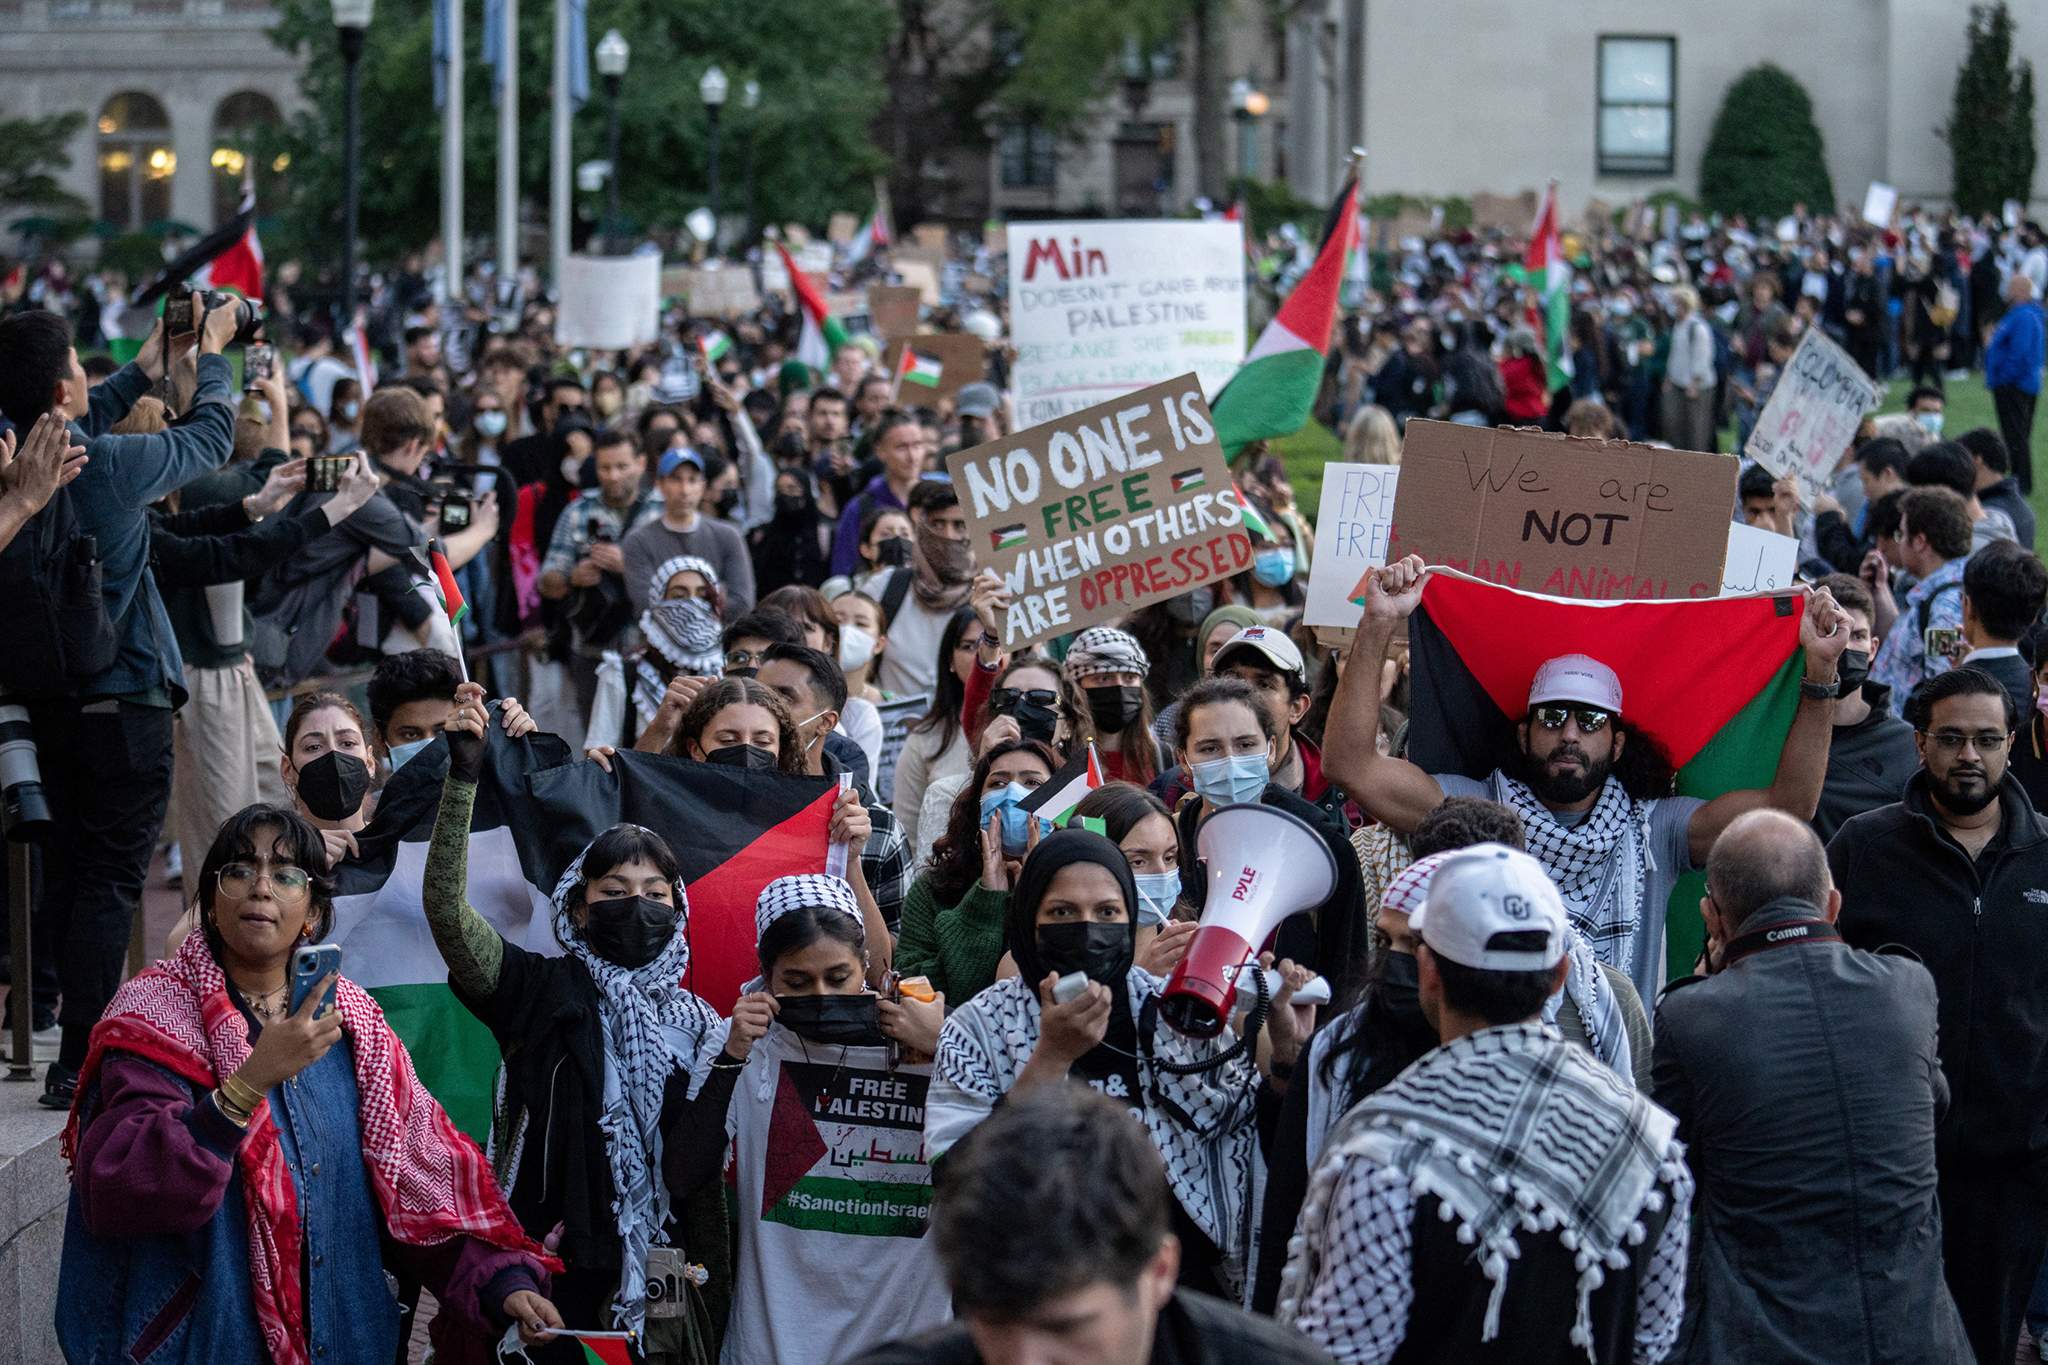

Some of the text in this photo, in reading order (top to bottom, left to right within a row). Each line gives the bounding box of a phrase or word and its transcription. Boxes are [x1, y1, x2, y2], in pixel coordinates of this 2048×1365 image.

[1023, 237, 1108, 281] Min
[1139, 277, 1199, 297] CARE
[1066, 302, 1208, 336] PALESTINE
[963, 391, 1214, 519] NO ONE IS
[1340, 472, 1397, 520] FRE
[1462, 450, 1673, 512] We are
[1042, 472, 1153, 539] FREE
[983, 489, 1243, 596] WHEN OTHERS
[1521, 509, 1629, 546] NOT
[1005, 533, 1251, 646] ARE OPPRESSED
[1231, 866, 1256, 901] PYLE
[1766, 926, 1808, 942] Canon
[849, 1077, 907, 1100] FREE
[815, 1095, 923, 1124] PALESTIN
